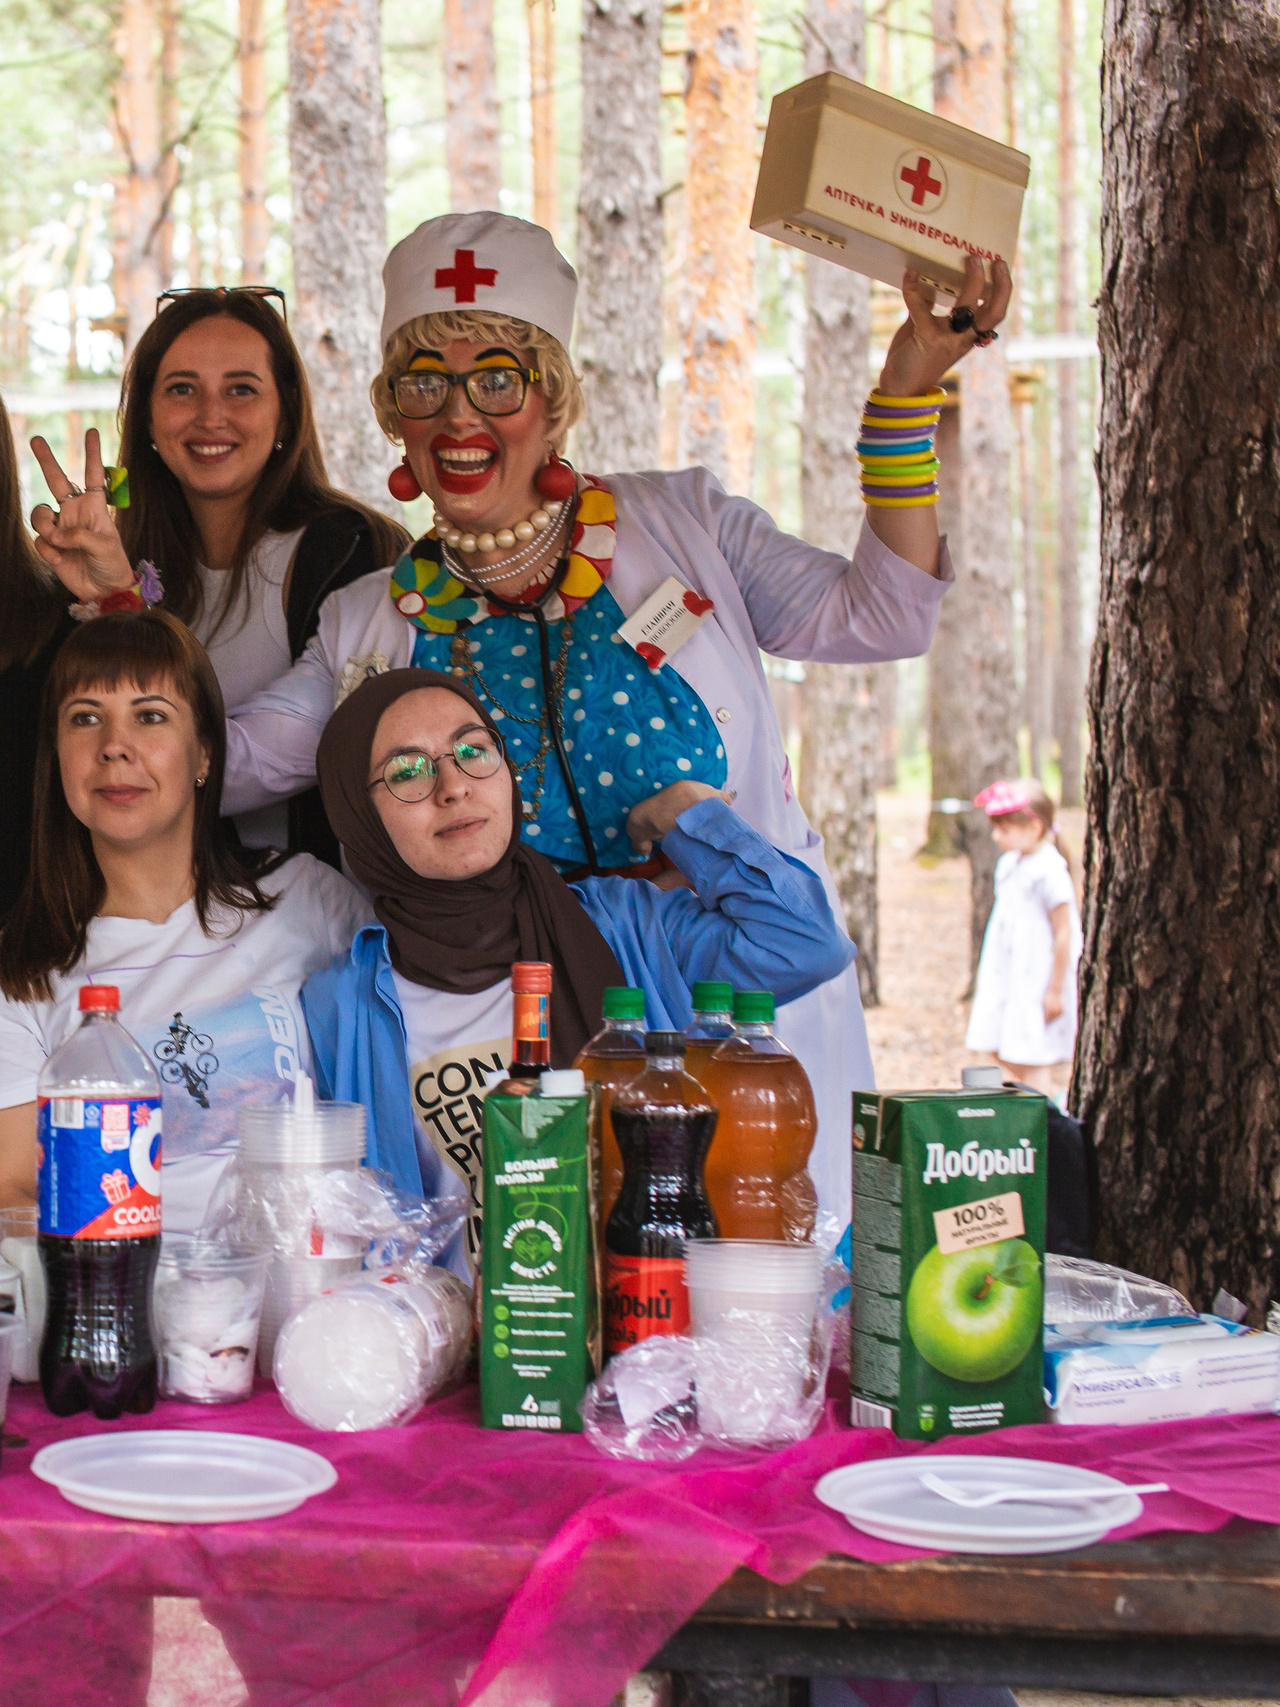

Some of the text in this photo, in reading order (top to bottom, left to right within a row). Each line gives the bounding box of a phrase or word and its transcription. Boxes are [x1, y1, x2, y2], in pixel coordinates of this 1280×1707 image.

[824, 185, 1003, 261] АПТЕЧКА УНИВЕРСАЛЬНАЯ
[414, 1052, 505, 1109] CON
[504, 1156, 559, 1173] БОЛЬШЕ
[923, 1138, 1035, 1185] Добрый
[494, 1171, 545, 1186] ПОЛЬЗЫ
[953, 1199, 1005, 1227] 100%
[502, 1218, 536, 1249] РАСТИМ
[510, 1260, 557, 1279] ВМЕСТЕ
